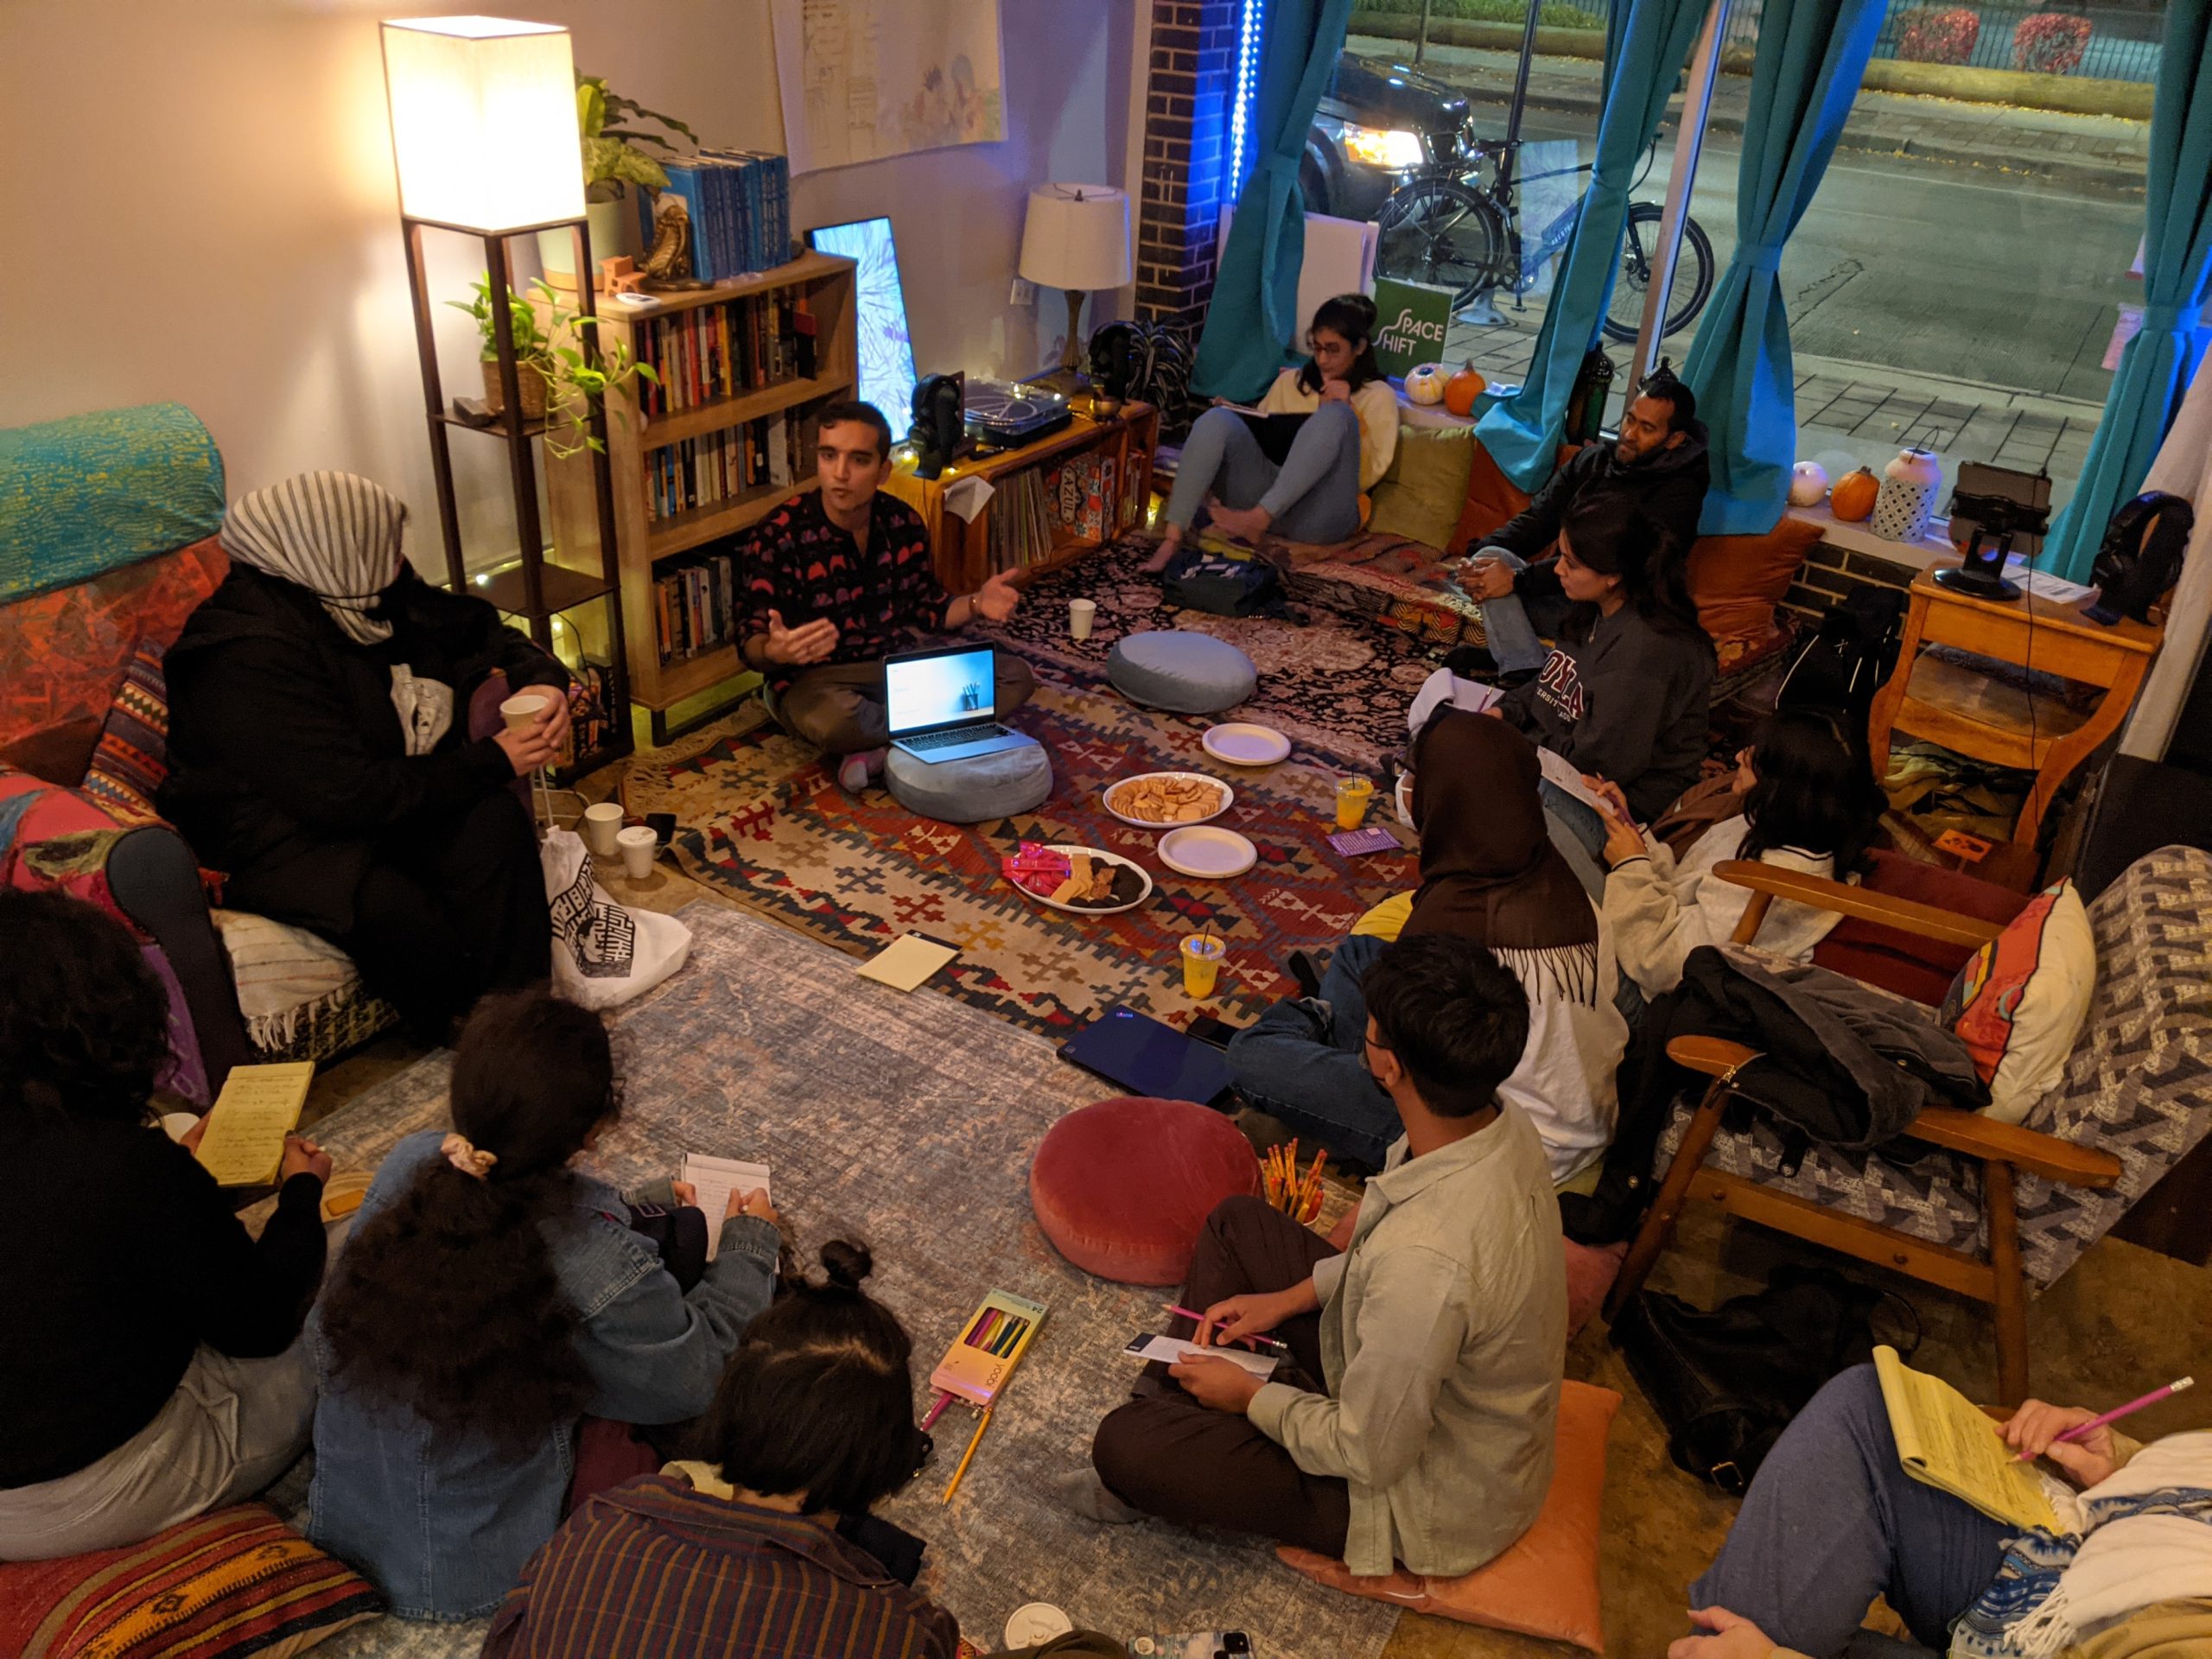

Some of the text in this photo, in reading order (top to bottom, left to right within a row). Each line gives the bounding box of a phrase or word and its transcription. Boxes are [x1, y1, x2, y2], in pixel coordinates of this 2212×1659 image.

[1372, 326, 1417, 356] SHIFT
[1384, 308, 1444, 341] SPACE
[1064, 475, 1075, 513] AZUL
[1539, 650, 1585, 720] OYLA
